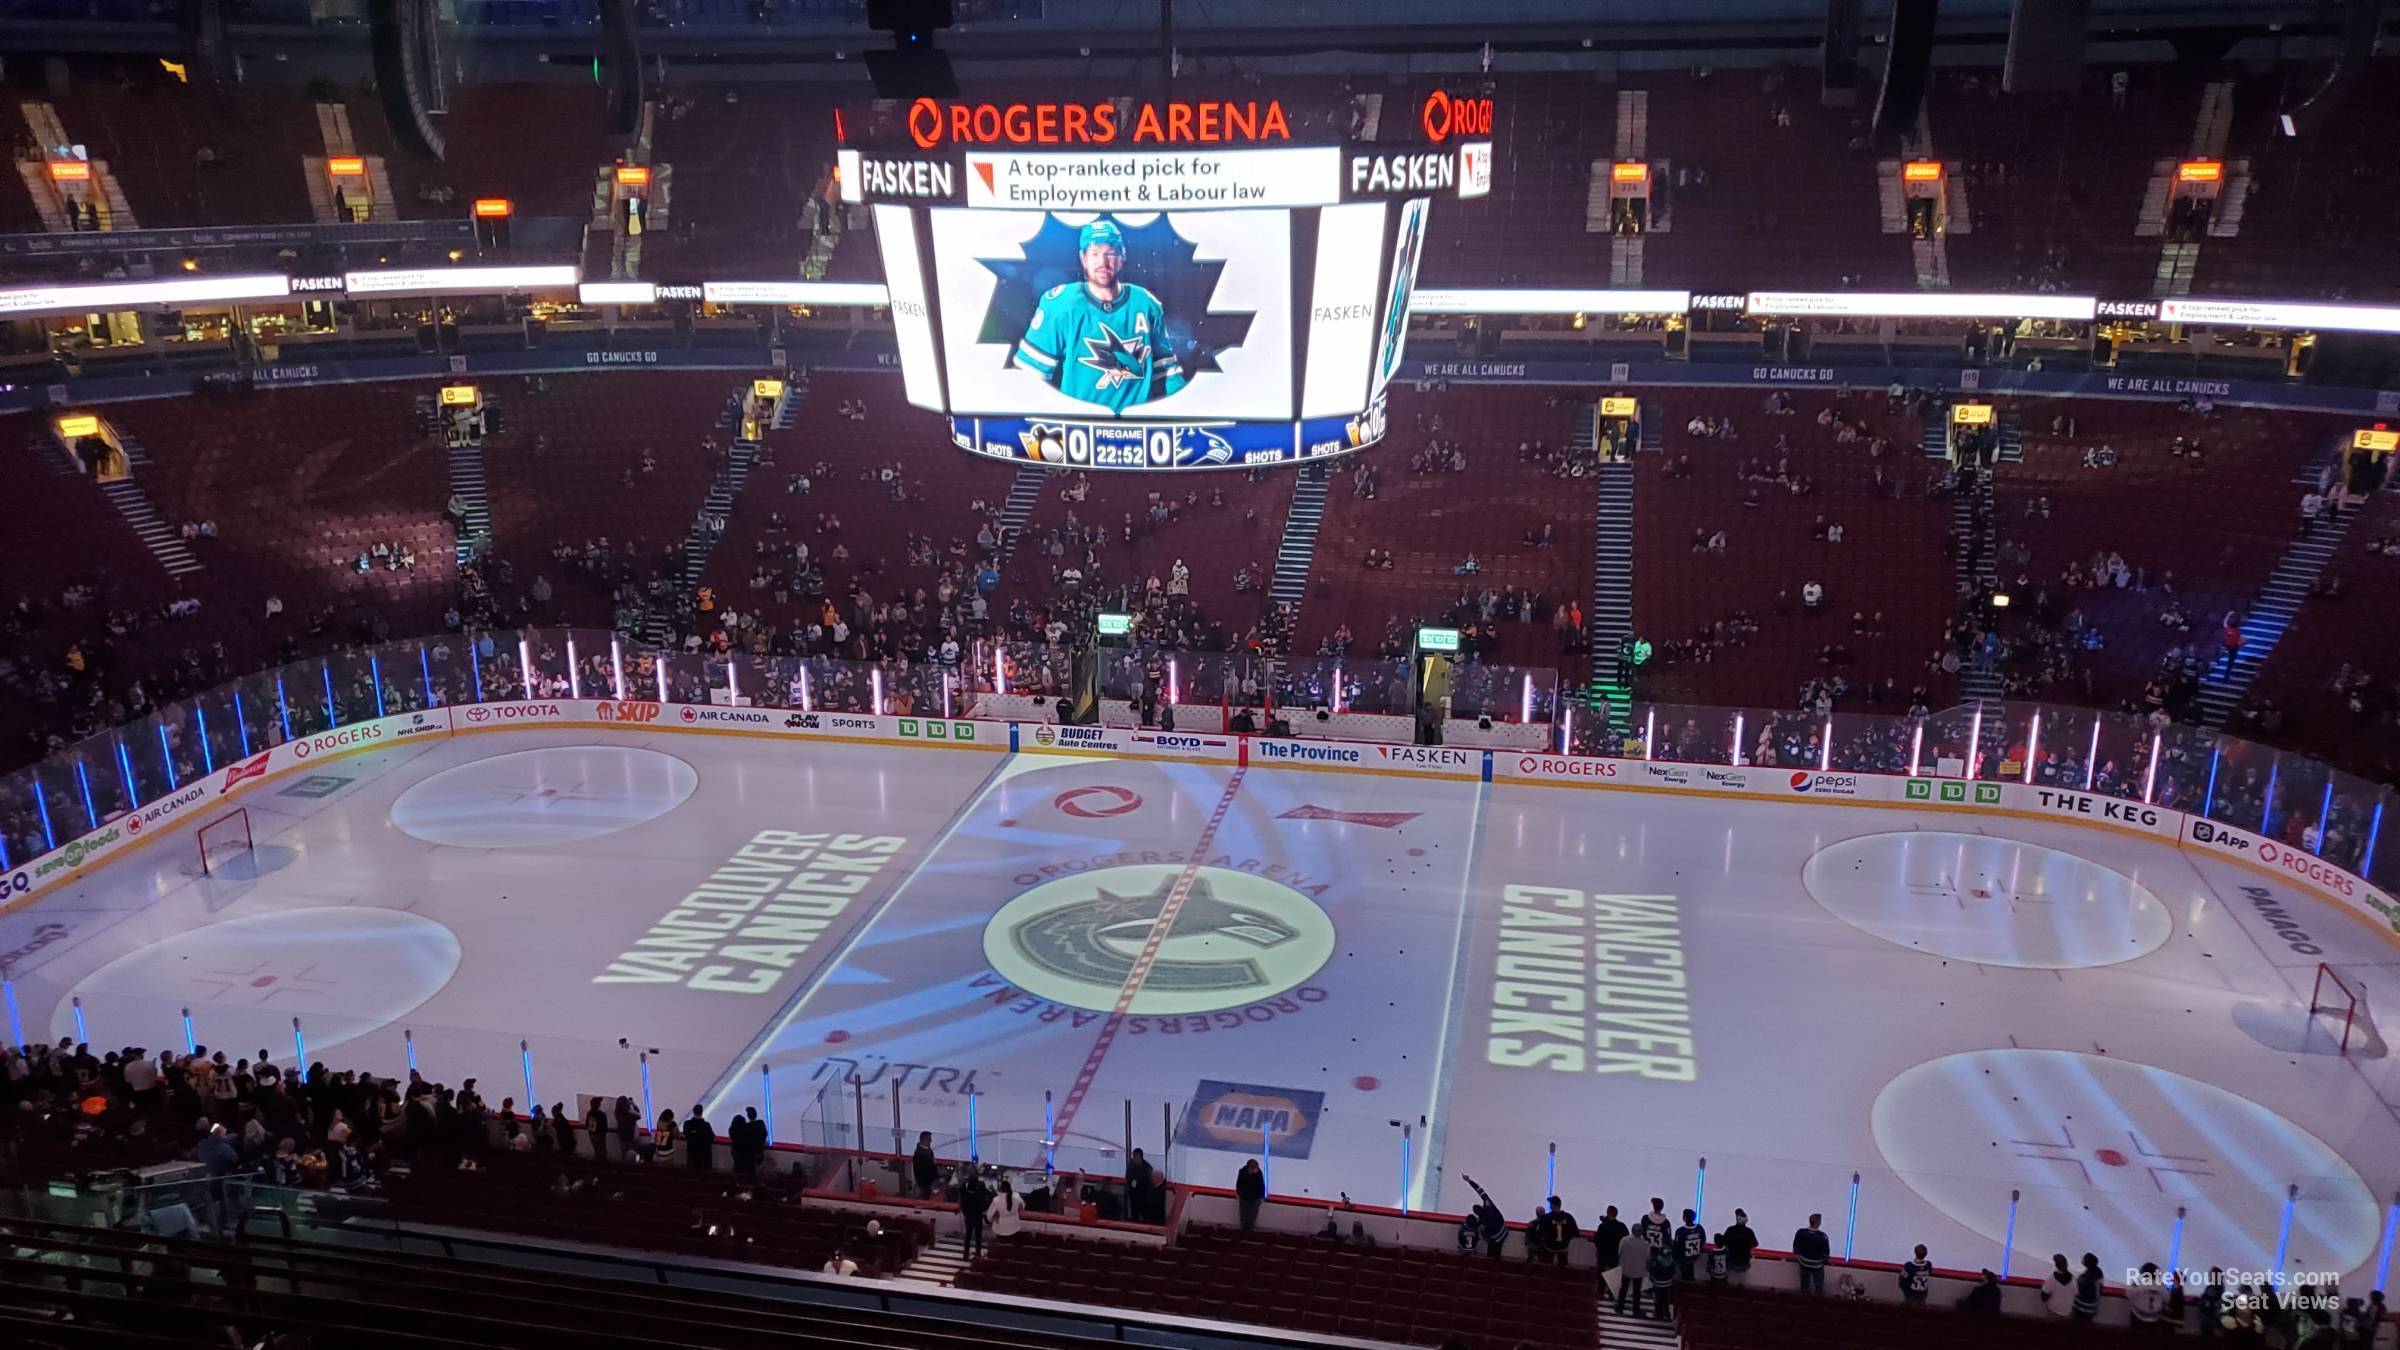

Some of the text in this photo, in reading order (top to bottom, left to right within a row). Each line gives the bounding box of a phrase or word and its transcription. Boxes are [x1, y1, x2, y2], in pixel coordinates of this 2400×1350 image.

[952, 100, 1291, 143] ROGERS ARENA
[1455, 100, 1493, 135] ROGE
[862, 160, 955, 197] FASKEN
[1008, 158, 1221, 182] A top-ranked pick for
[1352, 154, 1454, 193] FASKEN
[1010, 183, 1266, 205] Employment & Labour law
[292, 277, 343, 290] FASKEN
[656, 286, 701, 298] FASKEN
[893, 300, 926, 317] FASKEN
[1314, 304, 1372, 322] FASKEN
[2098, 303, 2157, 316] FASKEN
[1135, 312, 1149, 334] A
[587, 351, 657, 363] GO CANUCKS GO
[877, 354, 891, 365] WE
[252, 368, 269, 380] ALL
[272, 366, 319, 379] CANUCKS
[1424, 364, 1526, 376] WE ARE ALL CANUCKS
[1754, 368, 1833, 380] GO CANUCKS GO
[2108, 377, 2230, 395] WE ARE ALL CANUCKS
[986, 442, 1013, 457] SHOTS
[1069, 428, 1170, 461] 0 PREGAME 0
[1311, 442, 1339, 456] SHOTS
[1096, 446, 1143, 464] 22:52
[1245, 449, 1282, 463] SHOTS
[493, 704, 560, 718] TOYOTA
[615, 702, 660, 722] SKIP
[700, 711, 770, 723] AIR CANADA
[791, 713, 819, 721] PLAY
[791, 721, 820, 729] NOW
[832, 718, 876, 729] SPORTS
[901, 721, 918, 733] TD
[928, 723, 945, 736] TD
[956, 725, 973, 737] TD
[315, 724, 382, 752] ROGERS
[1061, 728, 1103, 741] BUDGET
[1157, 736, 1201, 747] BOYD
[1058, 739, 1118, 750] Auto Centres
[1259, 741, 1360, 762] The Province
[1392, 747, 1467, 765] FASKEN
[1543, 760, 1617, 777] ROGERS
[1649, 766, 1688, 777] NexGen
[1707, 770, 1746, 782] NexGen
[1664, 776, 1688, 785] Energy
[1721, 780, 1745, 788] Energy
[1815, 775, 1857, 788] pepsi
[1909, 782, 1929, 796] TD
[1944, 784, 1963, 798] TD
[1980, 786, 1998, 800] TD
[145, 787, 205, 824] AIR CANADA
[2038, 791, 2157, 826] THE KEG
[83, 828, 120, 853] foods
[1039, 850, 1332, 897] ROGERS ARENA
[2282, 853, 2353, 896] ROGERS
[592, 829, 831, 984] VANCOUVER
[686, 834, 907, 994] CANUCKS
[2239, 885, 2323, 955] PANAGO
[1487, 884, 1585, 1072] CANUCKS
[1594, 894, 1696, 1081] VANCOUVER
[968, 973, 1302, 1037] ROGERS ARENA
[1215, 1104, 1289, 1132] NAPA
[1647, 1230, 1663, 1248] 53
[1685, 1240, 1701, 1257] 53
